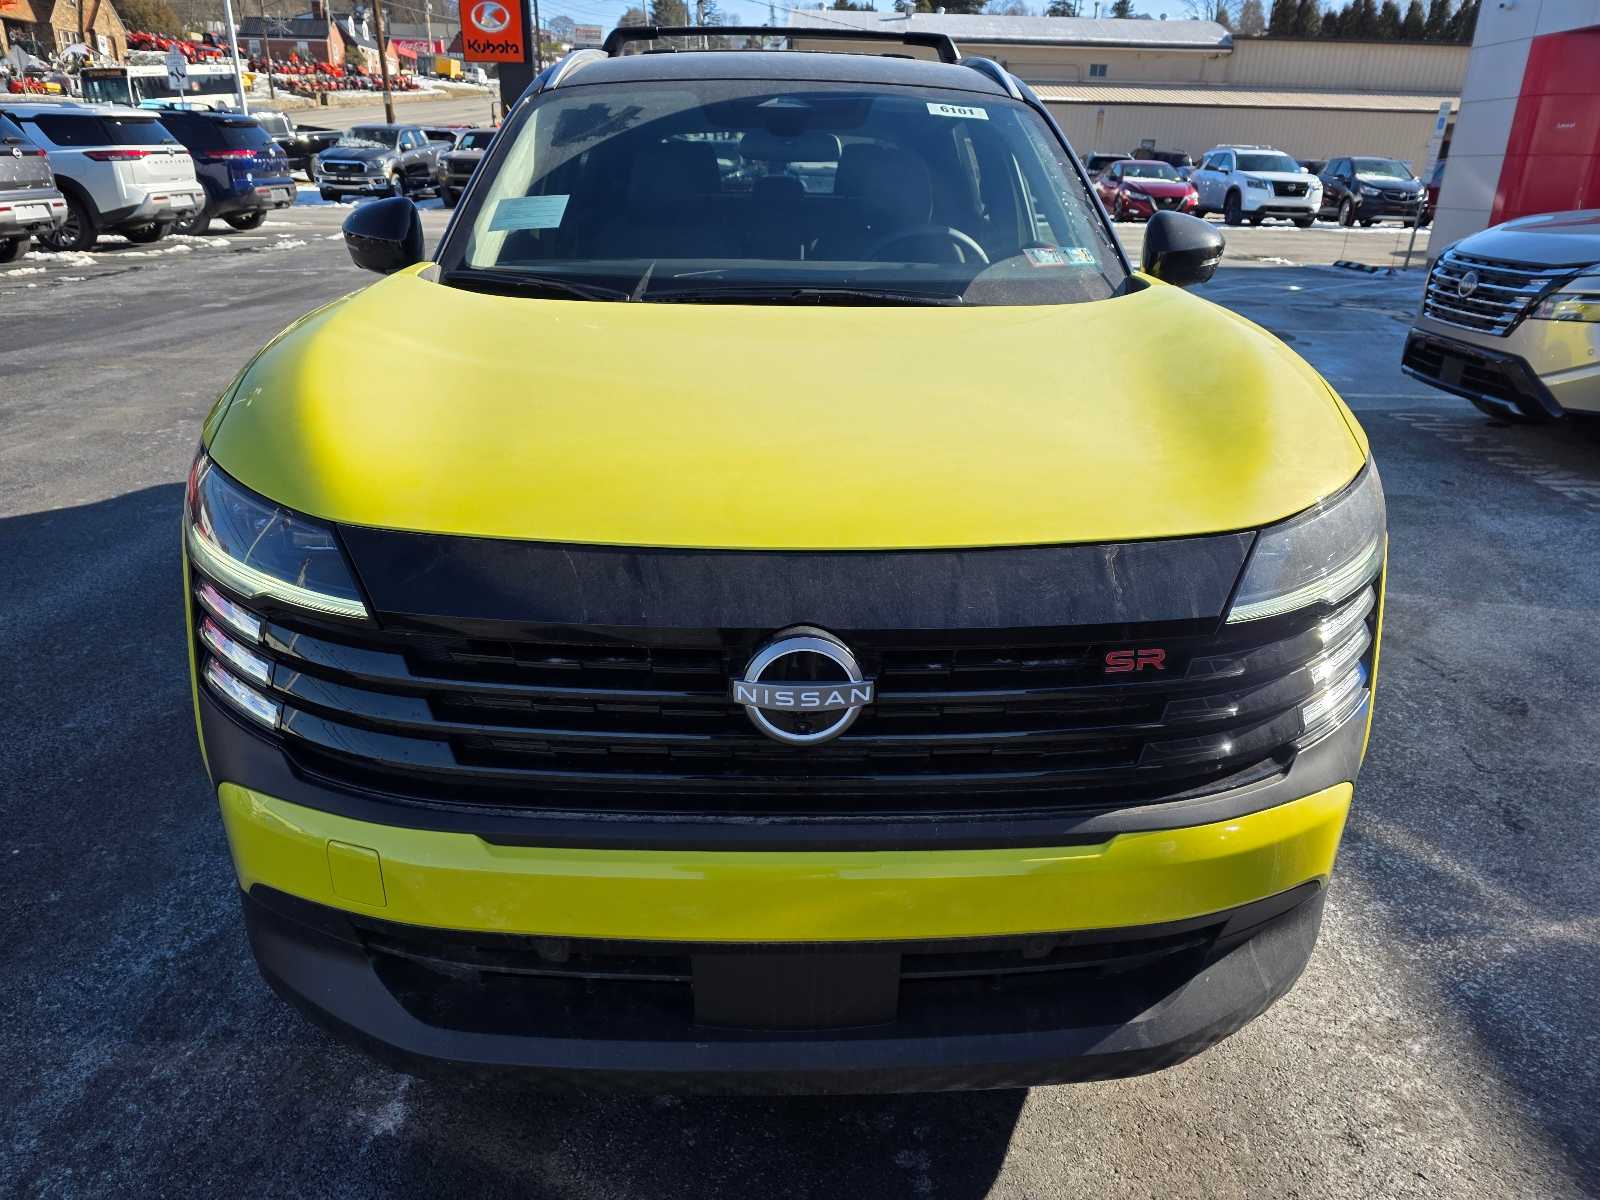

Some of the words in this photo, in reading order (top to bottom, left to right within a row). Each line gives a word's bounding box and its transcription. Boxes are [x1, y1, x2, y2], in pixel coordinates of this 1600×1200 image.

[467, 39, 519, 54] Kubota
[940, 105, 976, 116] 6101
[1105, 648, 1166, 673] SR
[736, 685, 871, 707] NISSAN
